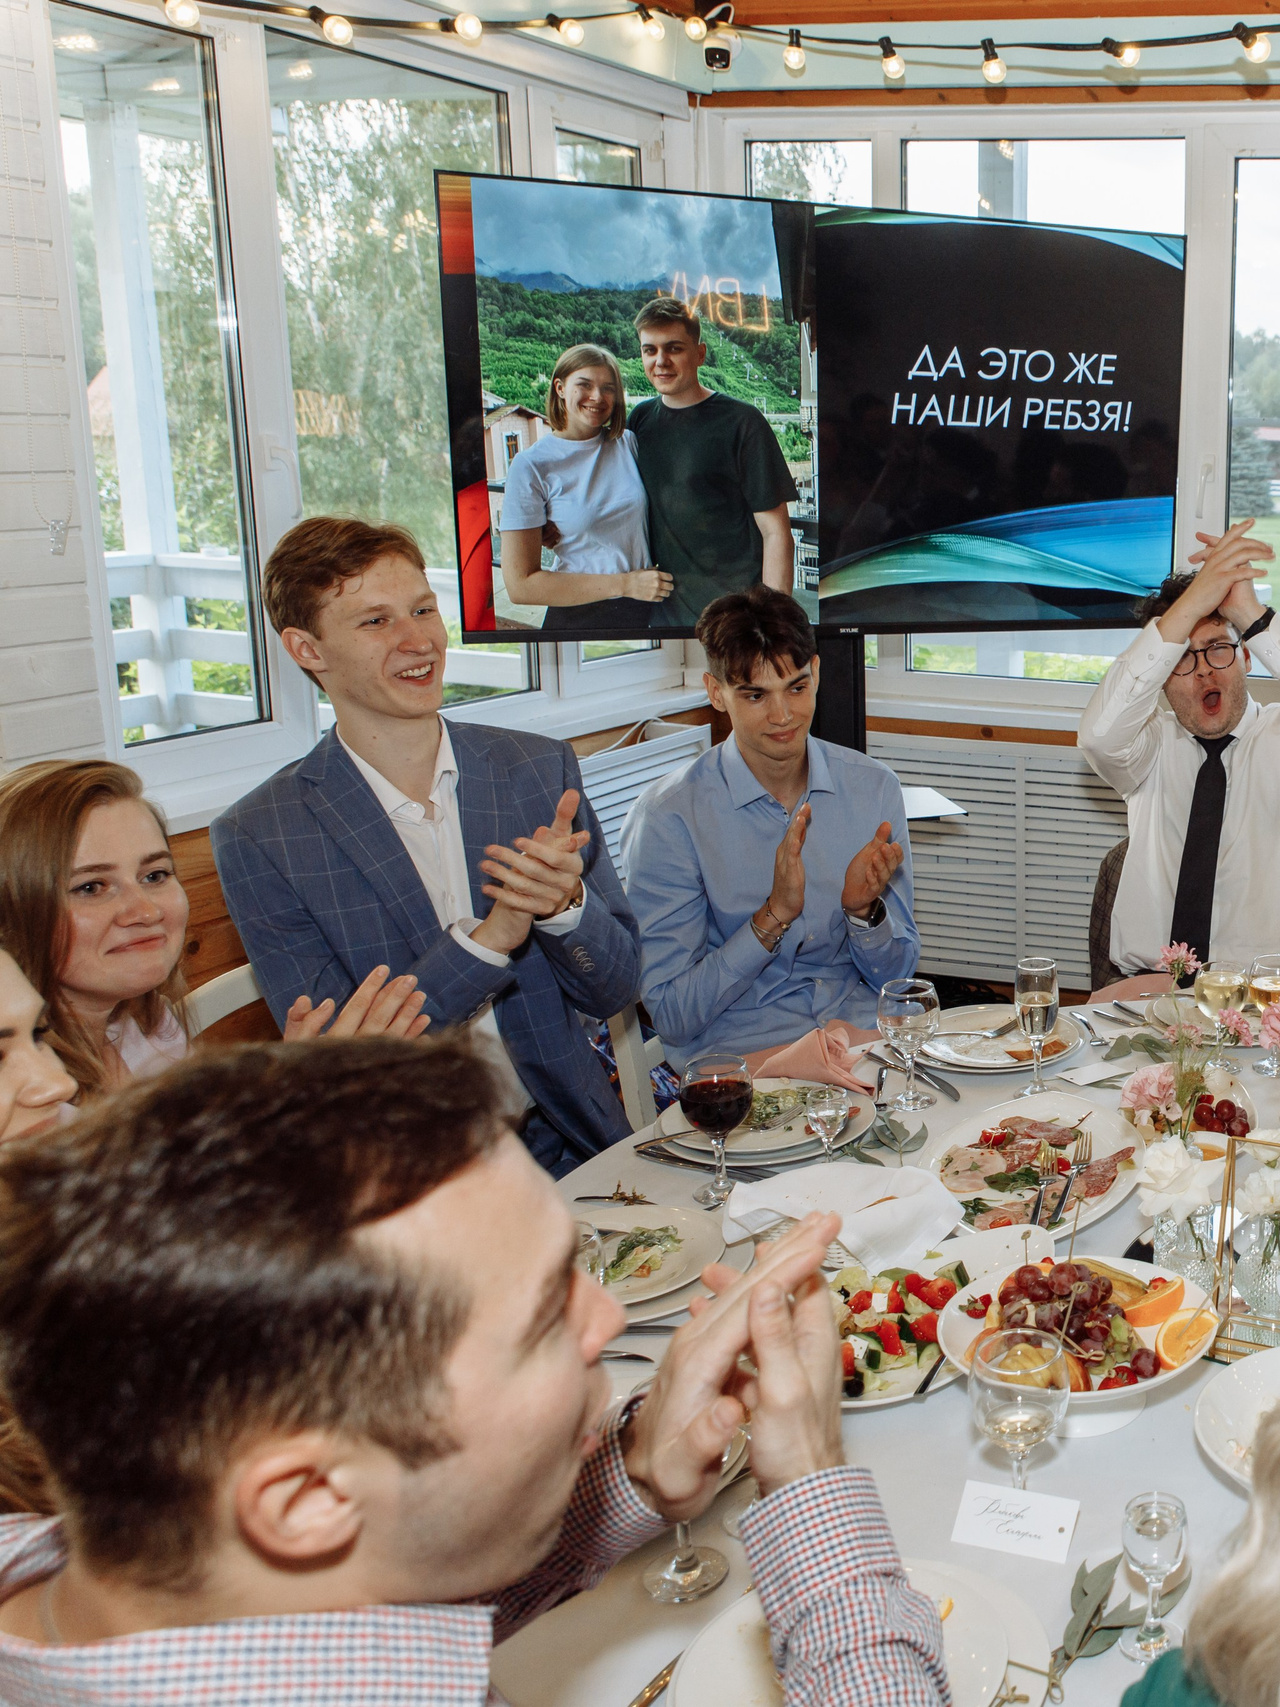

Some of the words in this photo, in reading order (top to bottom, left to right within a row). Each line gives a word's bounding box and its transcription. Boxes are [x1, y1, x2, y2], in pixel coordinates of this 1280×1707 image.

[907, 344, 966, 381] ДА
[977, 347, 1055, 382] ЭТО
[1062, 351, 1118, 385] ЖЕ
[891, 392, 1012, 428] НАШИ
[1022, 397, 1133, 433] РЕБЗЯ!
